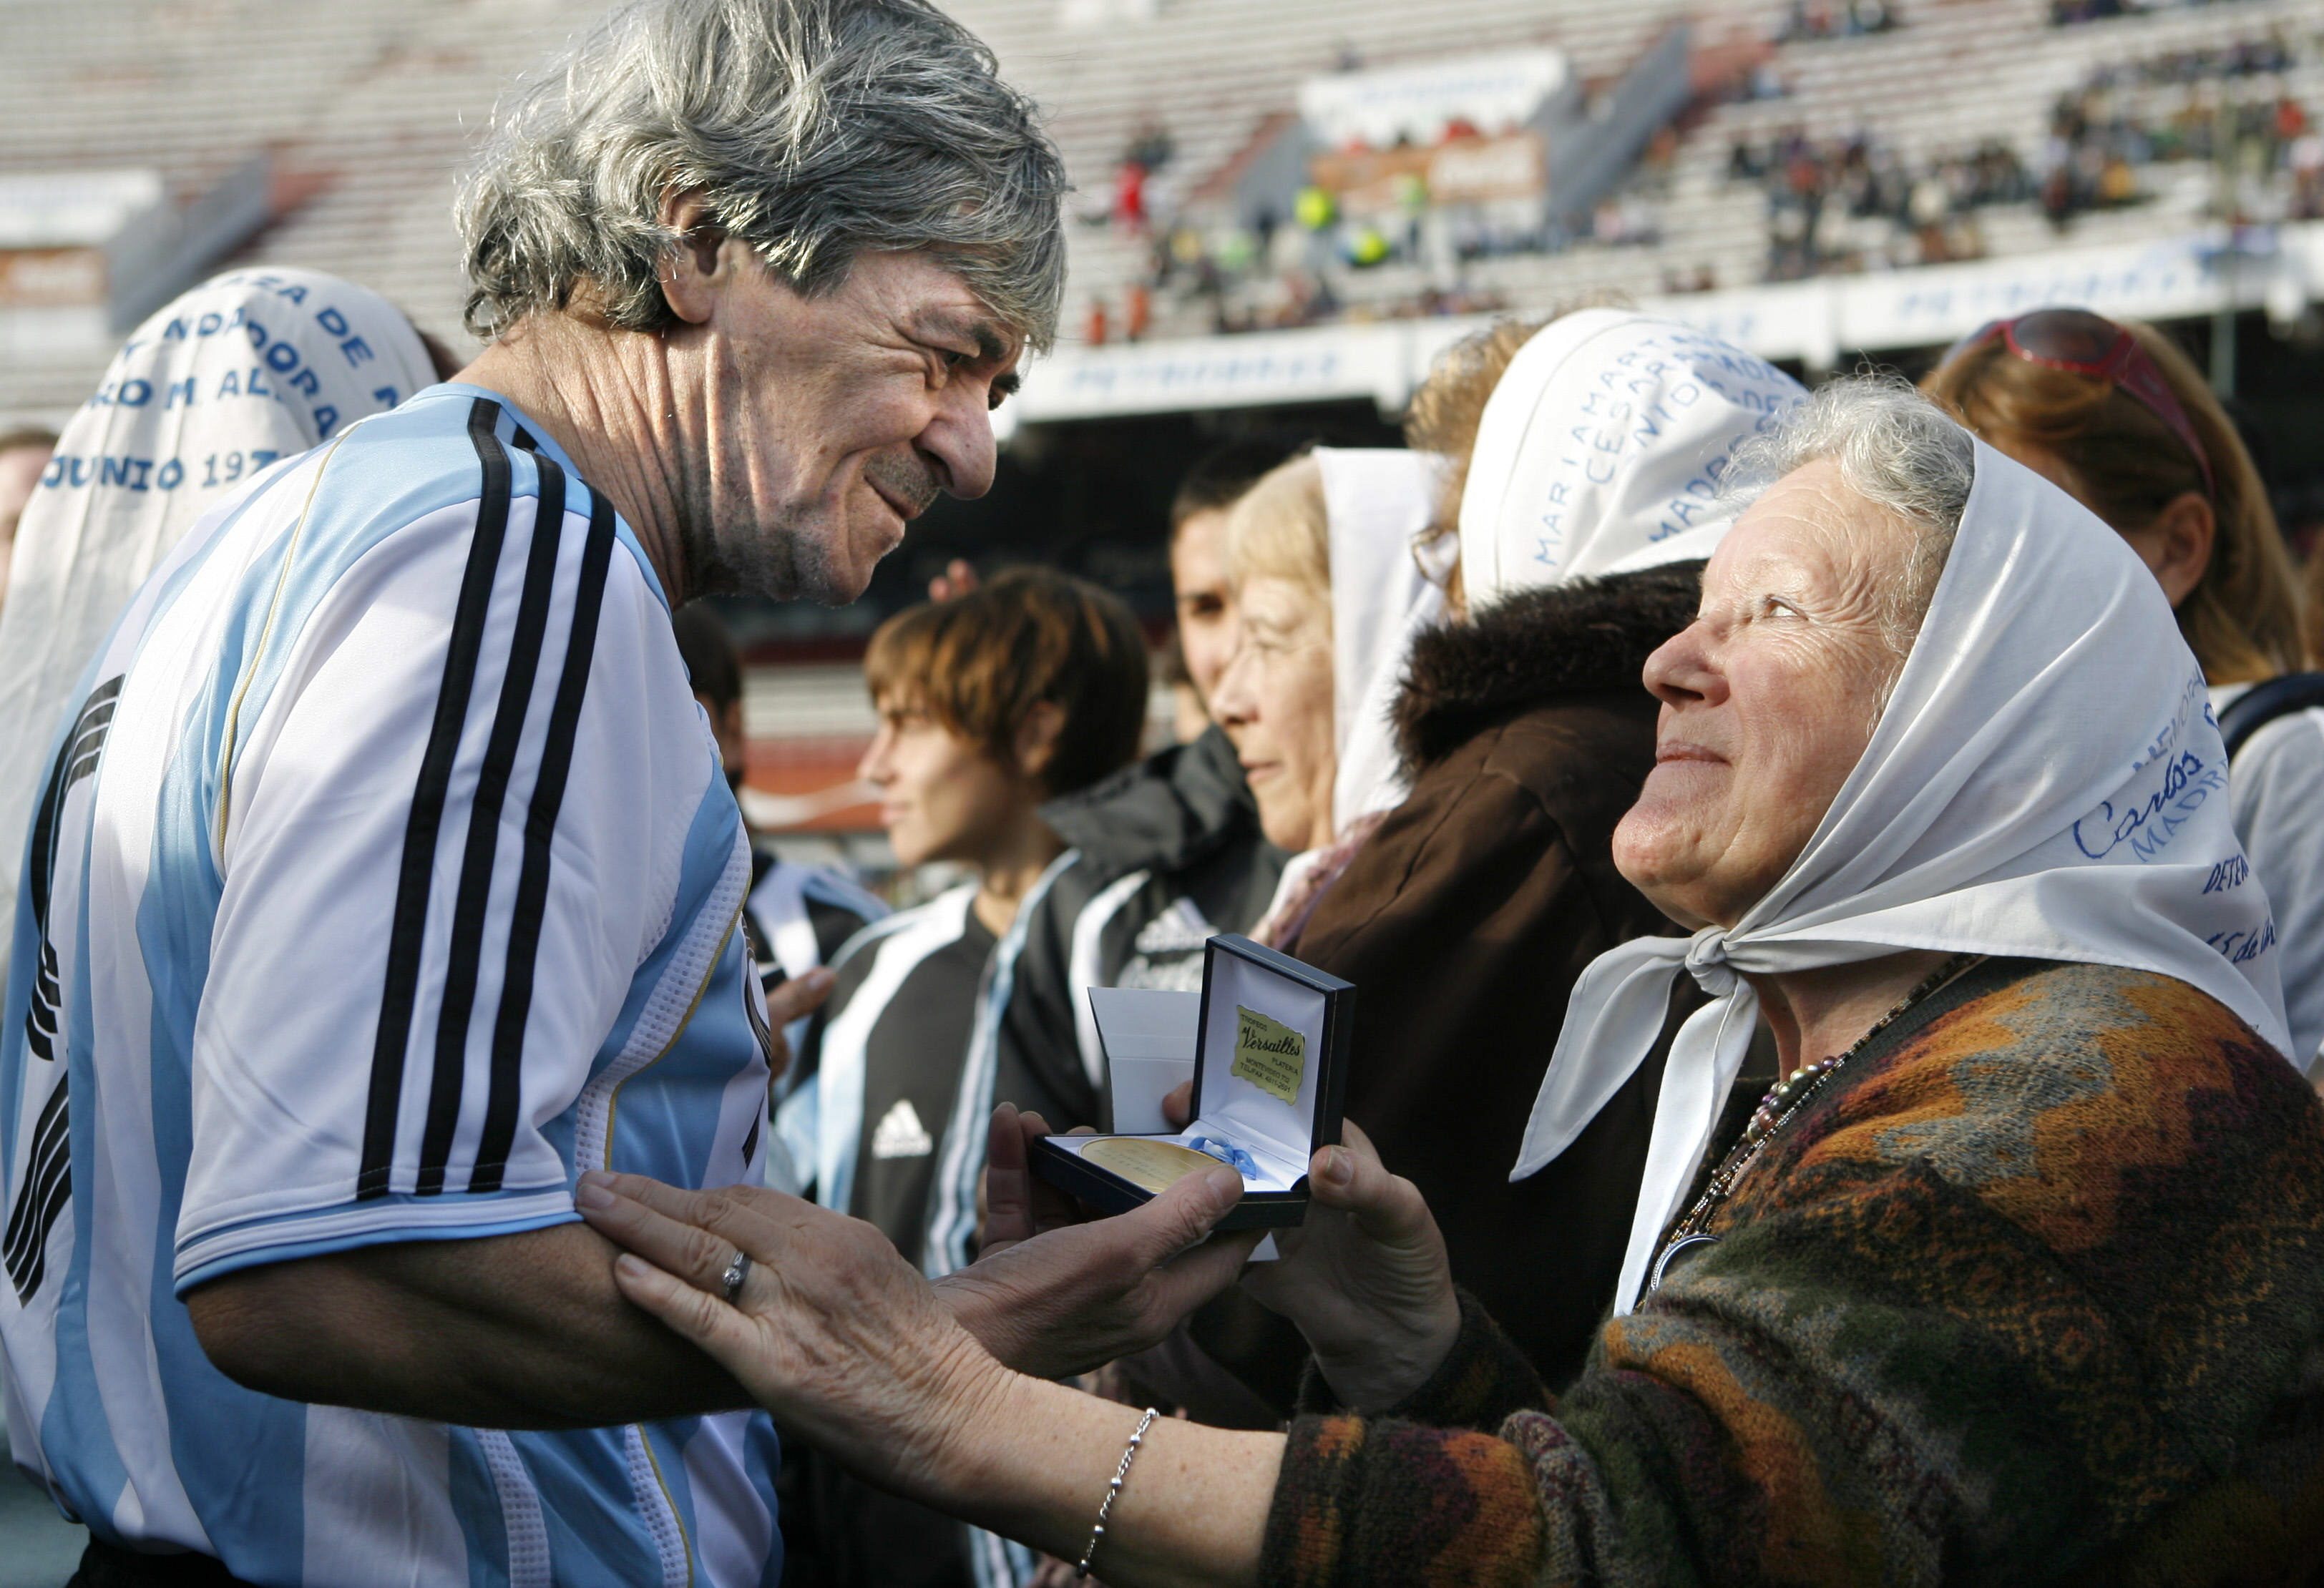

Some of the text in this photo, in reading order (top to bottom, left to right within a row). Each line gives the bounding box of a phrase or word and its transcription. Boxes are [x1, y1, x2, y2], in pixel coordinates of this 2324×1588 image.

[316, 307, 376, 368] DE
[42, 455, 185, 491] JUNIO
[2073, 750, 2204, 859] Carlos
[1241, 1026, 1301, 1057] Versailles
